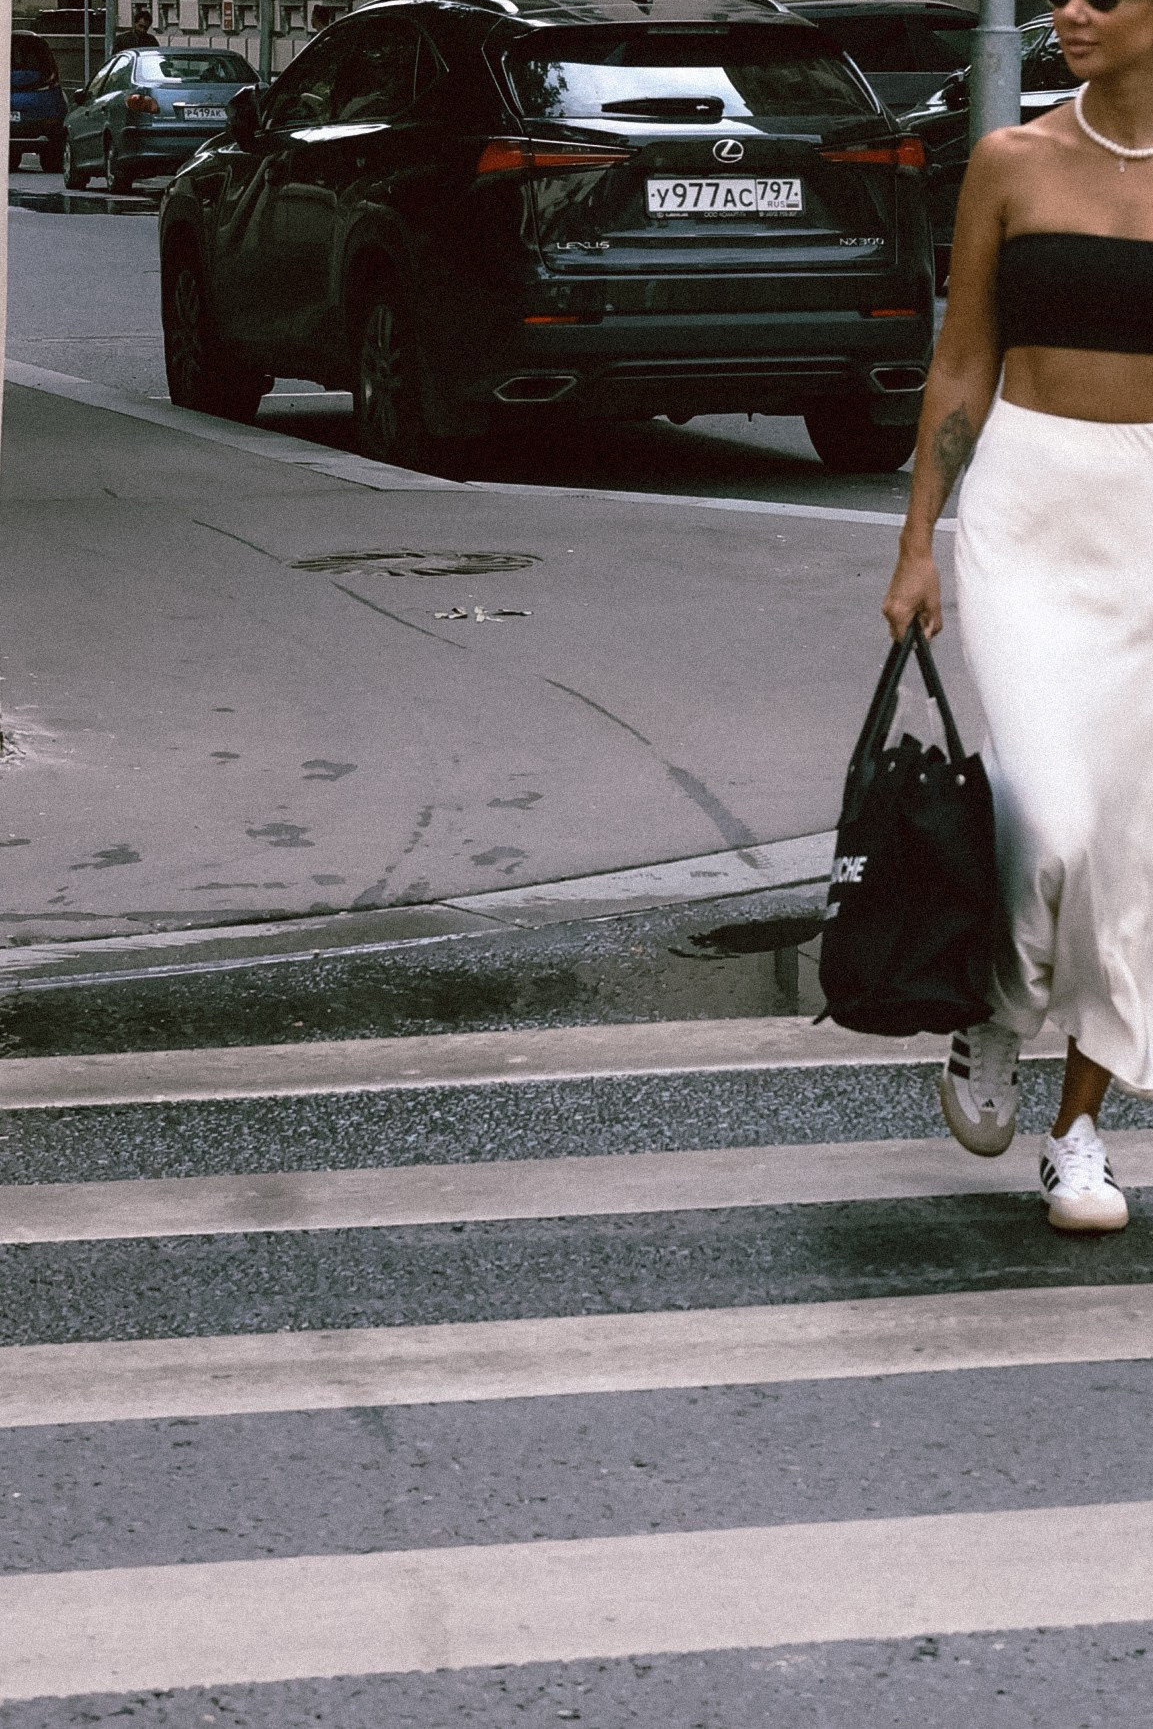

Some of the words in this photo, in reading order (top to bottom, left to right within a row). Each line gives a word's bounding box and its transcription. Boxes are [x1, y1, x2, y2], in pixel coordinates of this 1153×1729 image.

[657, 183, 753, 208] У977АС
[757, 181, 793, 201] 797
[556, 240, 610, 250] LEXUS
[839, 237, 858, 246] NX
[859, 237, 885, 246] 300
